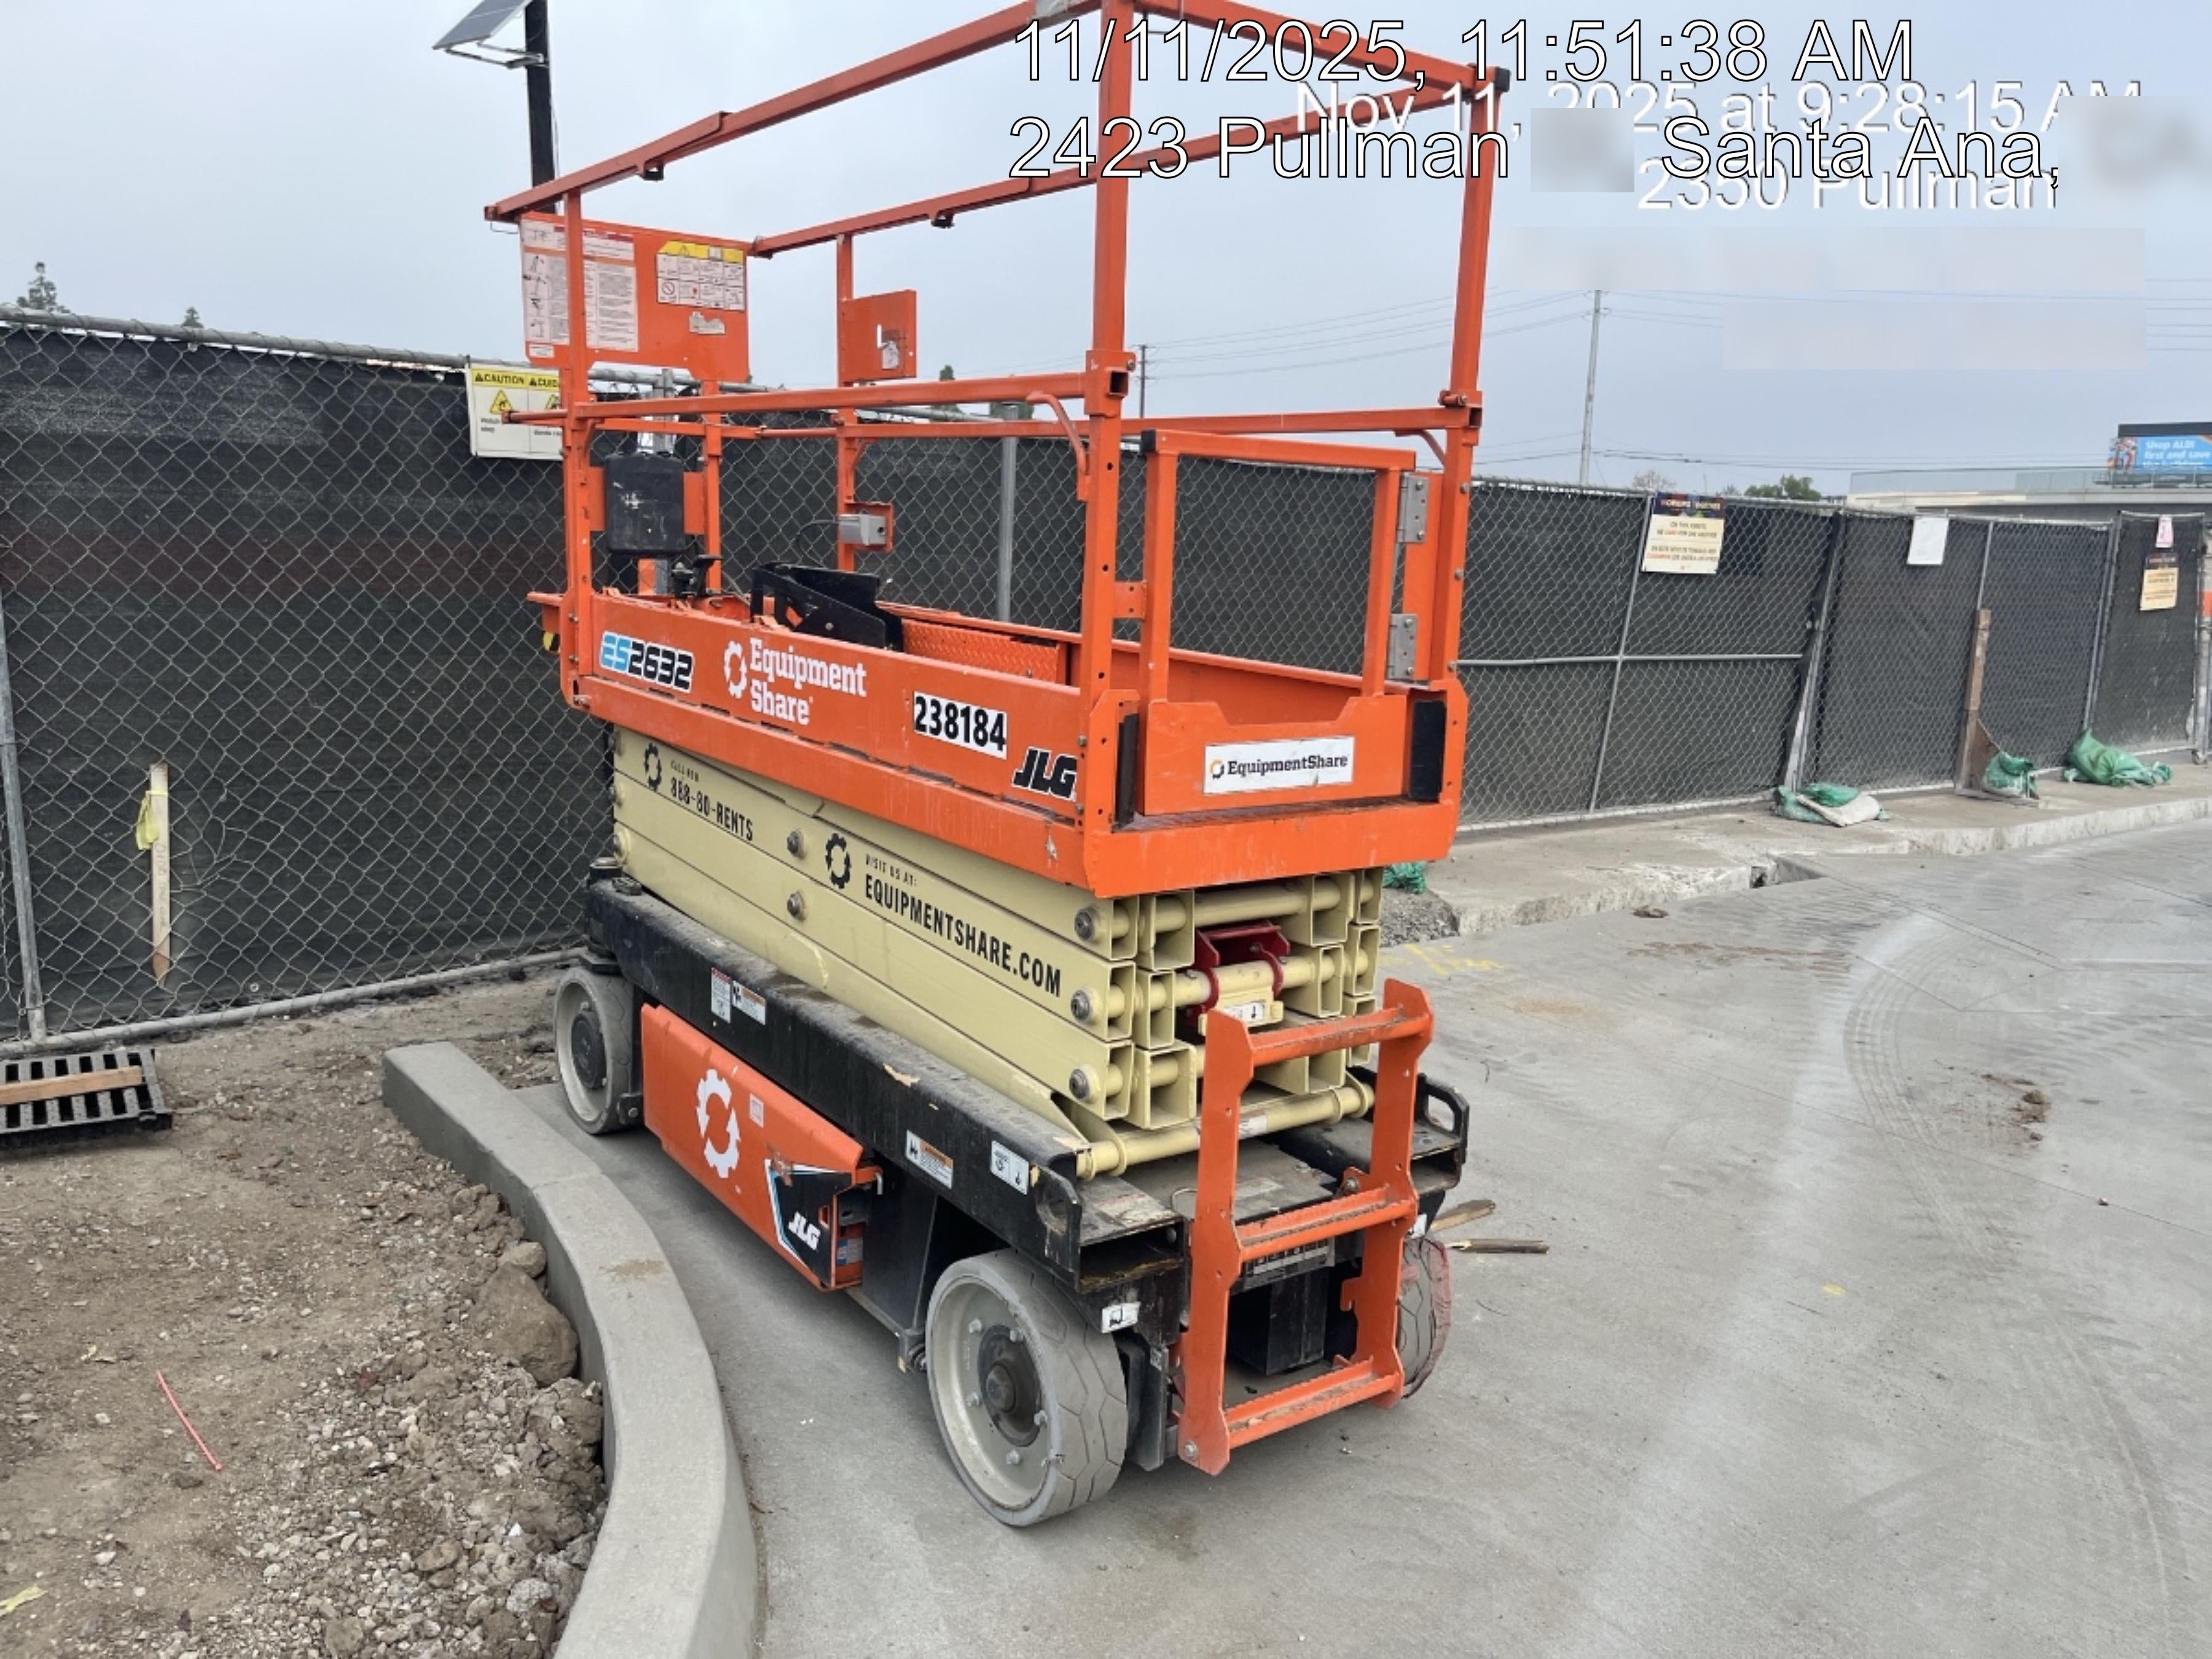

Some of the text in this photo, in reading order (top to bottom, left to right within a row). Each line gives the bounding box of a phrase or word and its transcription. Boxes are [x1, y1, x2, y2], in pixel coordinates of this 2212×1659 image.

[484, 373, 525, 385] CAUTION
[600, 632, 693, 692] ES2632
[749, 637, 867, 697] Equipment
[750, 679, 810, 726] Share
[914, 696, 1006, 751] 238184
[1011, 746, 1078, 802] JLG
[1227, 755, 1349, 778] EquipmentShare
[865, 853, 887, 874] VISIT
[889, 865, 900, 880] US
[865, 873, 1061, 998] EQUIPMENTSHARE.COM
[788, 1212, 822, 1251] JLG
